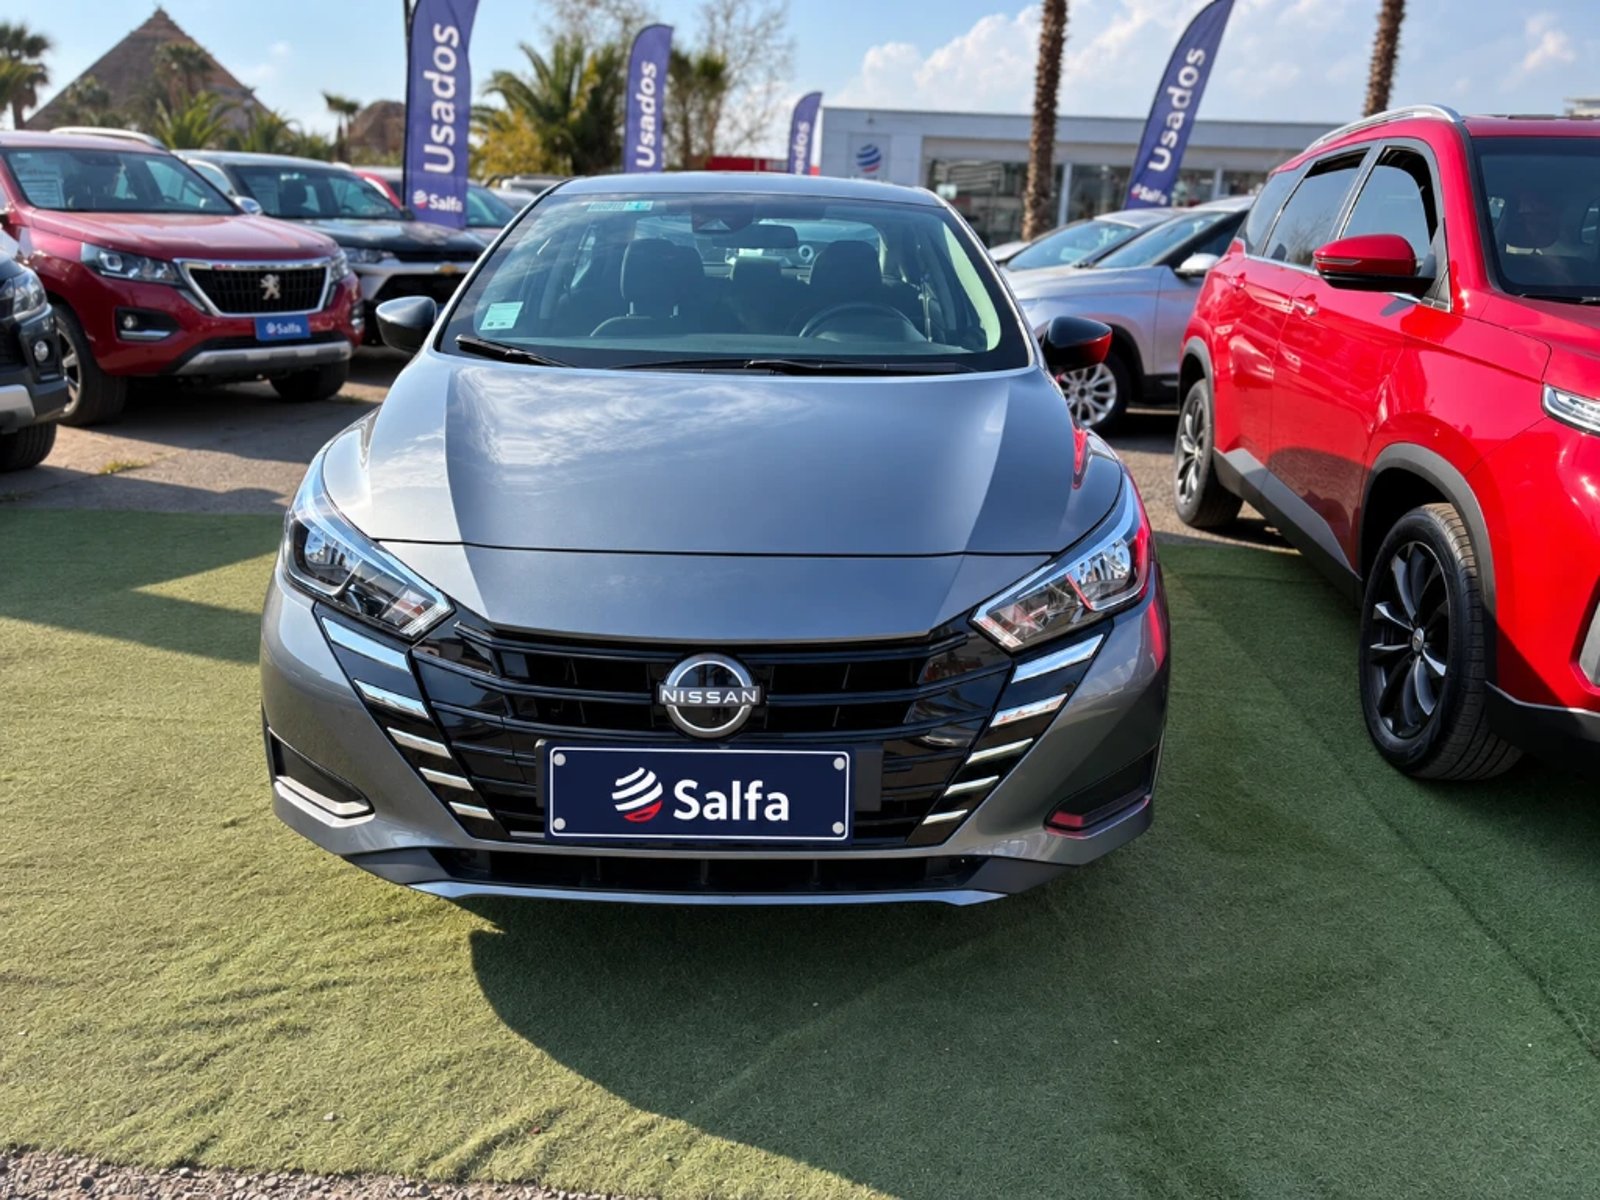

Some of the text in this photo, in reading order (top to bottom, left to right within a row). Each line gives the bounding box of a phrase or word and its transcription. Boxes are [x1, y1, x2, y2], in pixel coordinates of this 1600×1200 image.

[423, 23, 460, 174] Usados
[635, 61, 657, 168] Usados
[1147, 48, 1206, 172] Usados
[792, 121, 810, 174] ados
[429, 193, 463, 212] Salfa
[661, 689, 757, 704] NISSAN
[673, 779, 790, 822] Salfa
